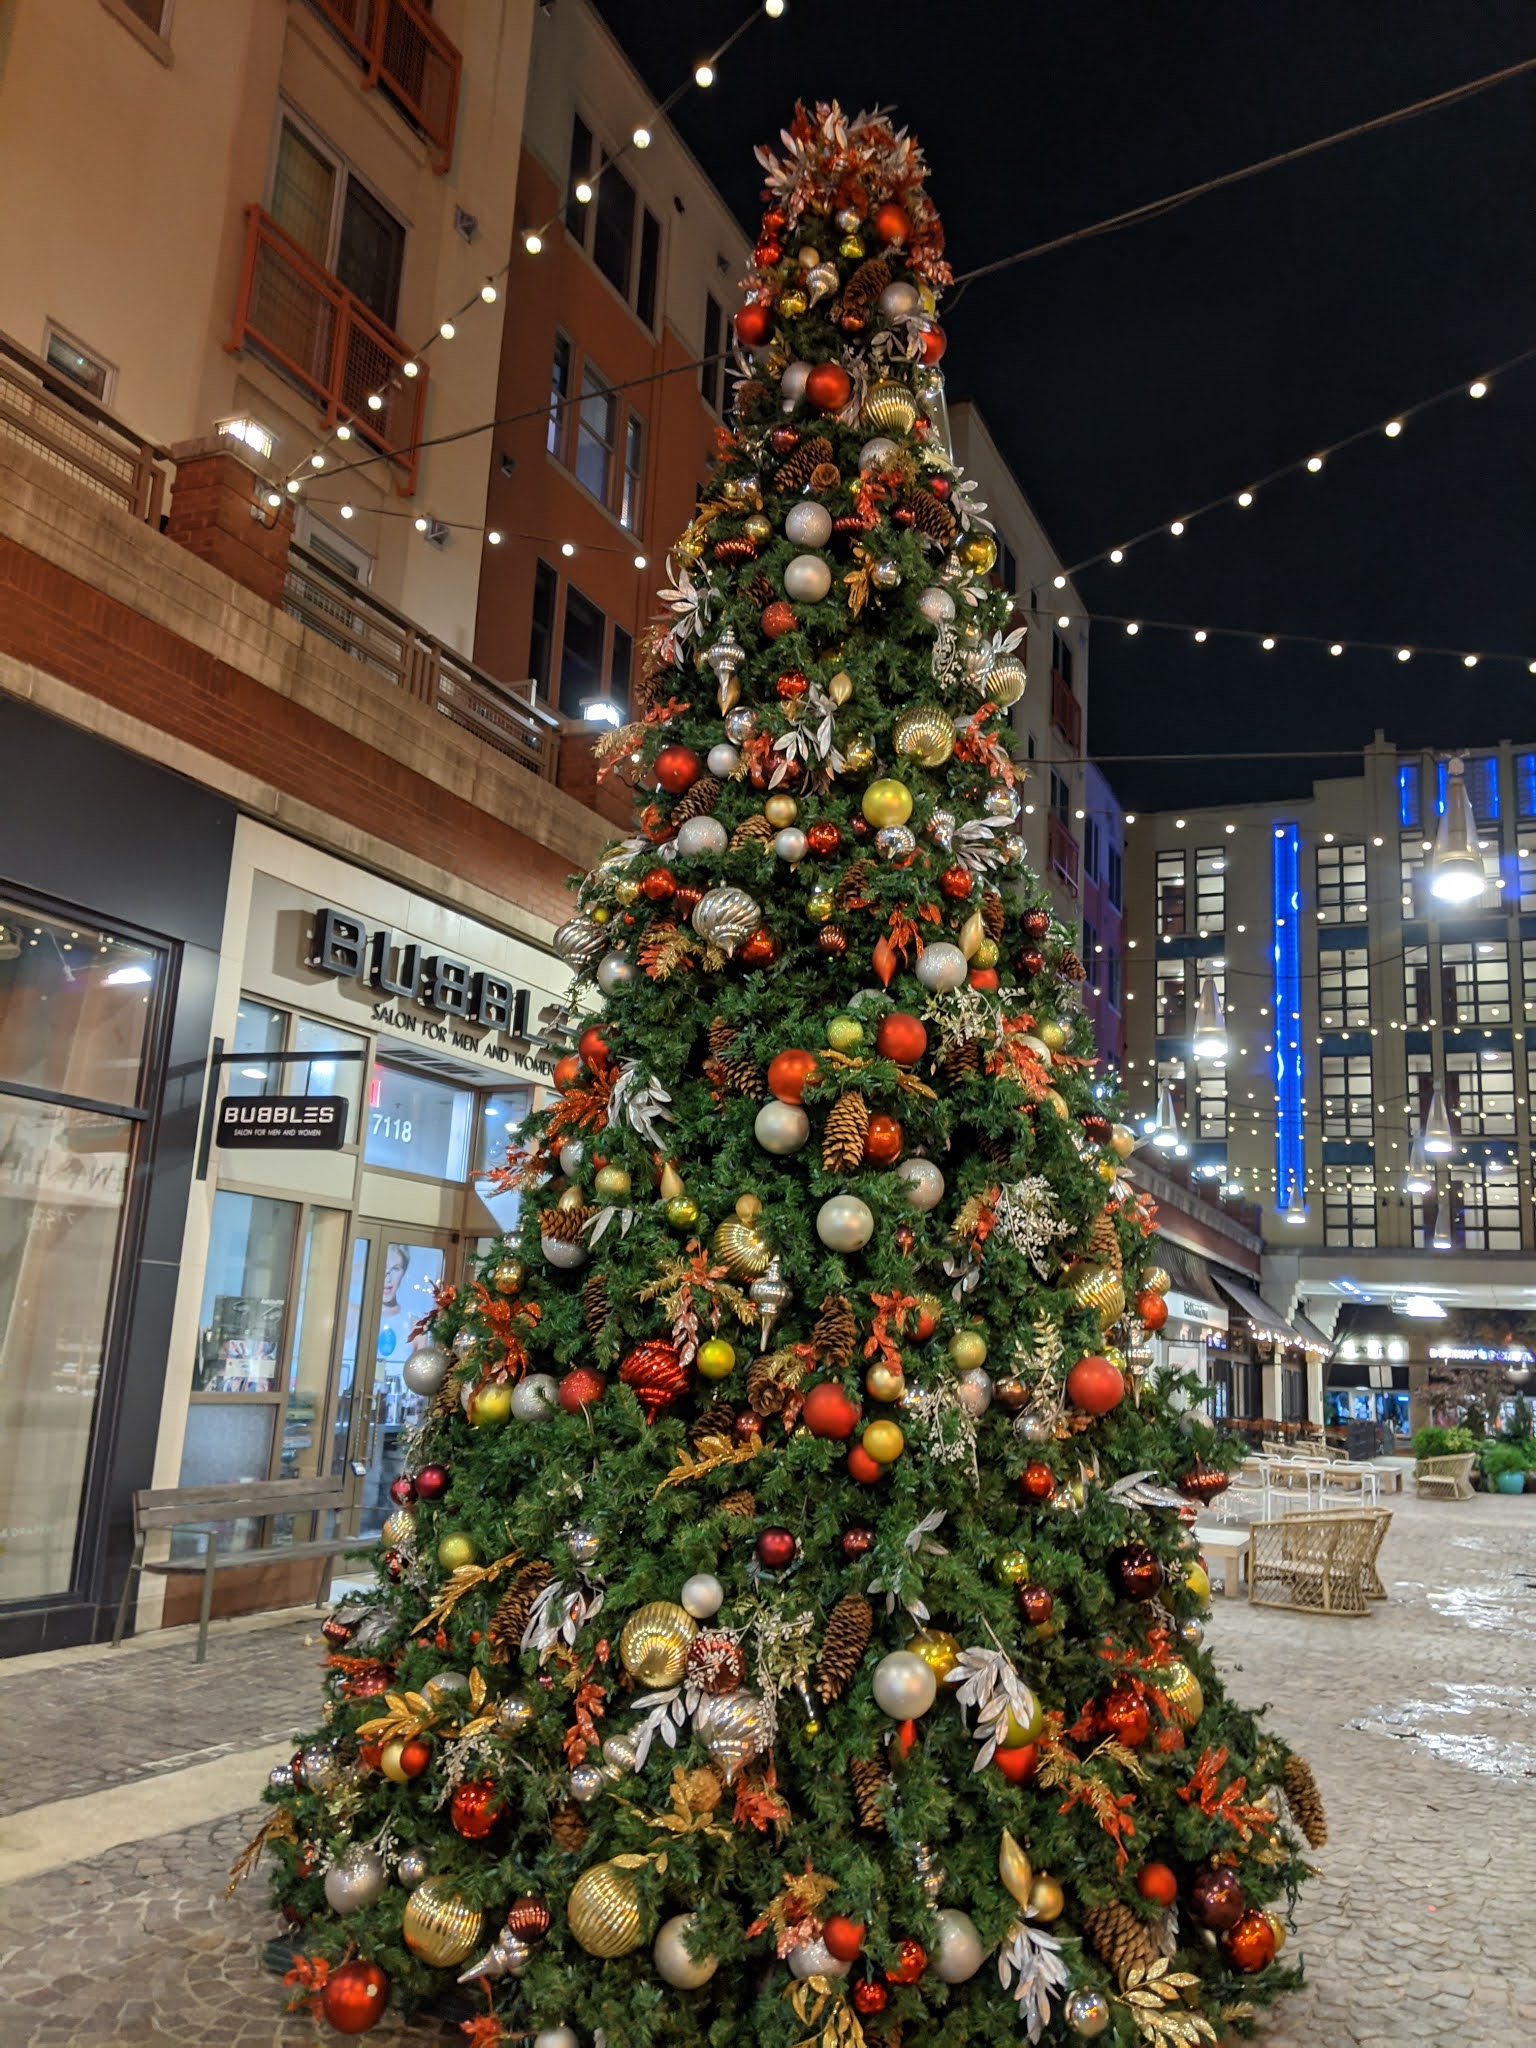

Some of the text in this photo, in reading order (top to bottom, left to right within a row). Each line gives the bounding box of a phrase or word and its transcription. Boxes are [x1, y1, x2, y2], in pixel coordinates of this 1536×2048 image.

[371, 1003, 556, 1077] SALON FOR MEN AND WOMEN
[224, 1106, 334, 1123] BUBBLES
[234, 1128, 321, 1137] SALON FOR MEN AND WOMEN
[373, 1113, 412, 1143] 7118
